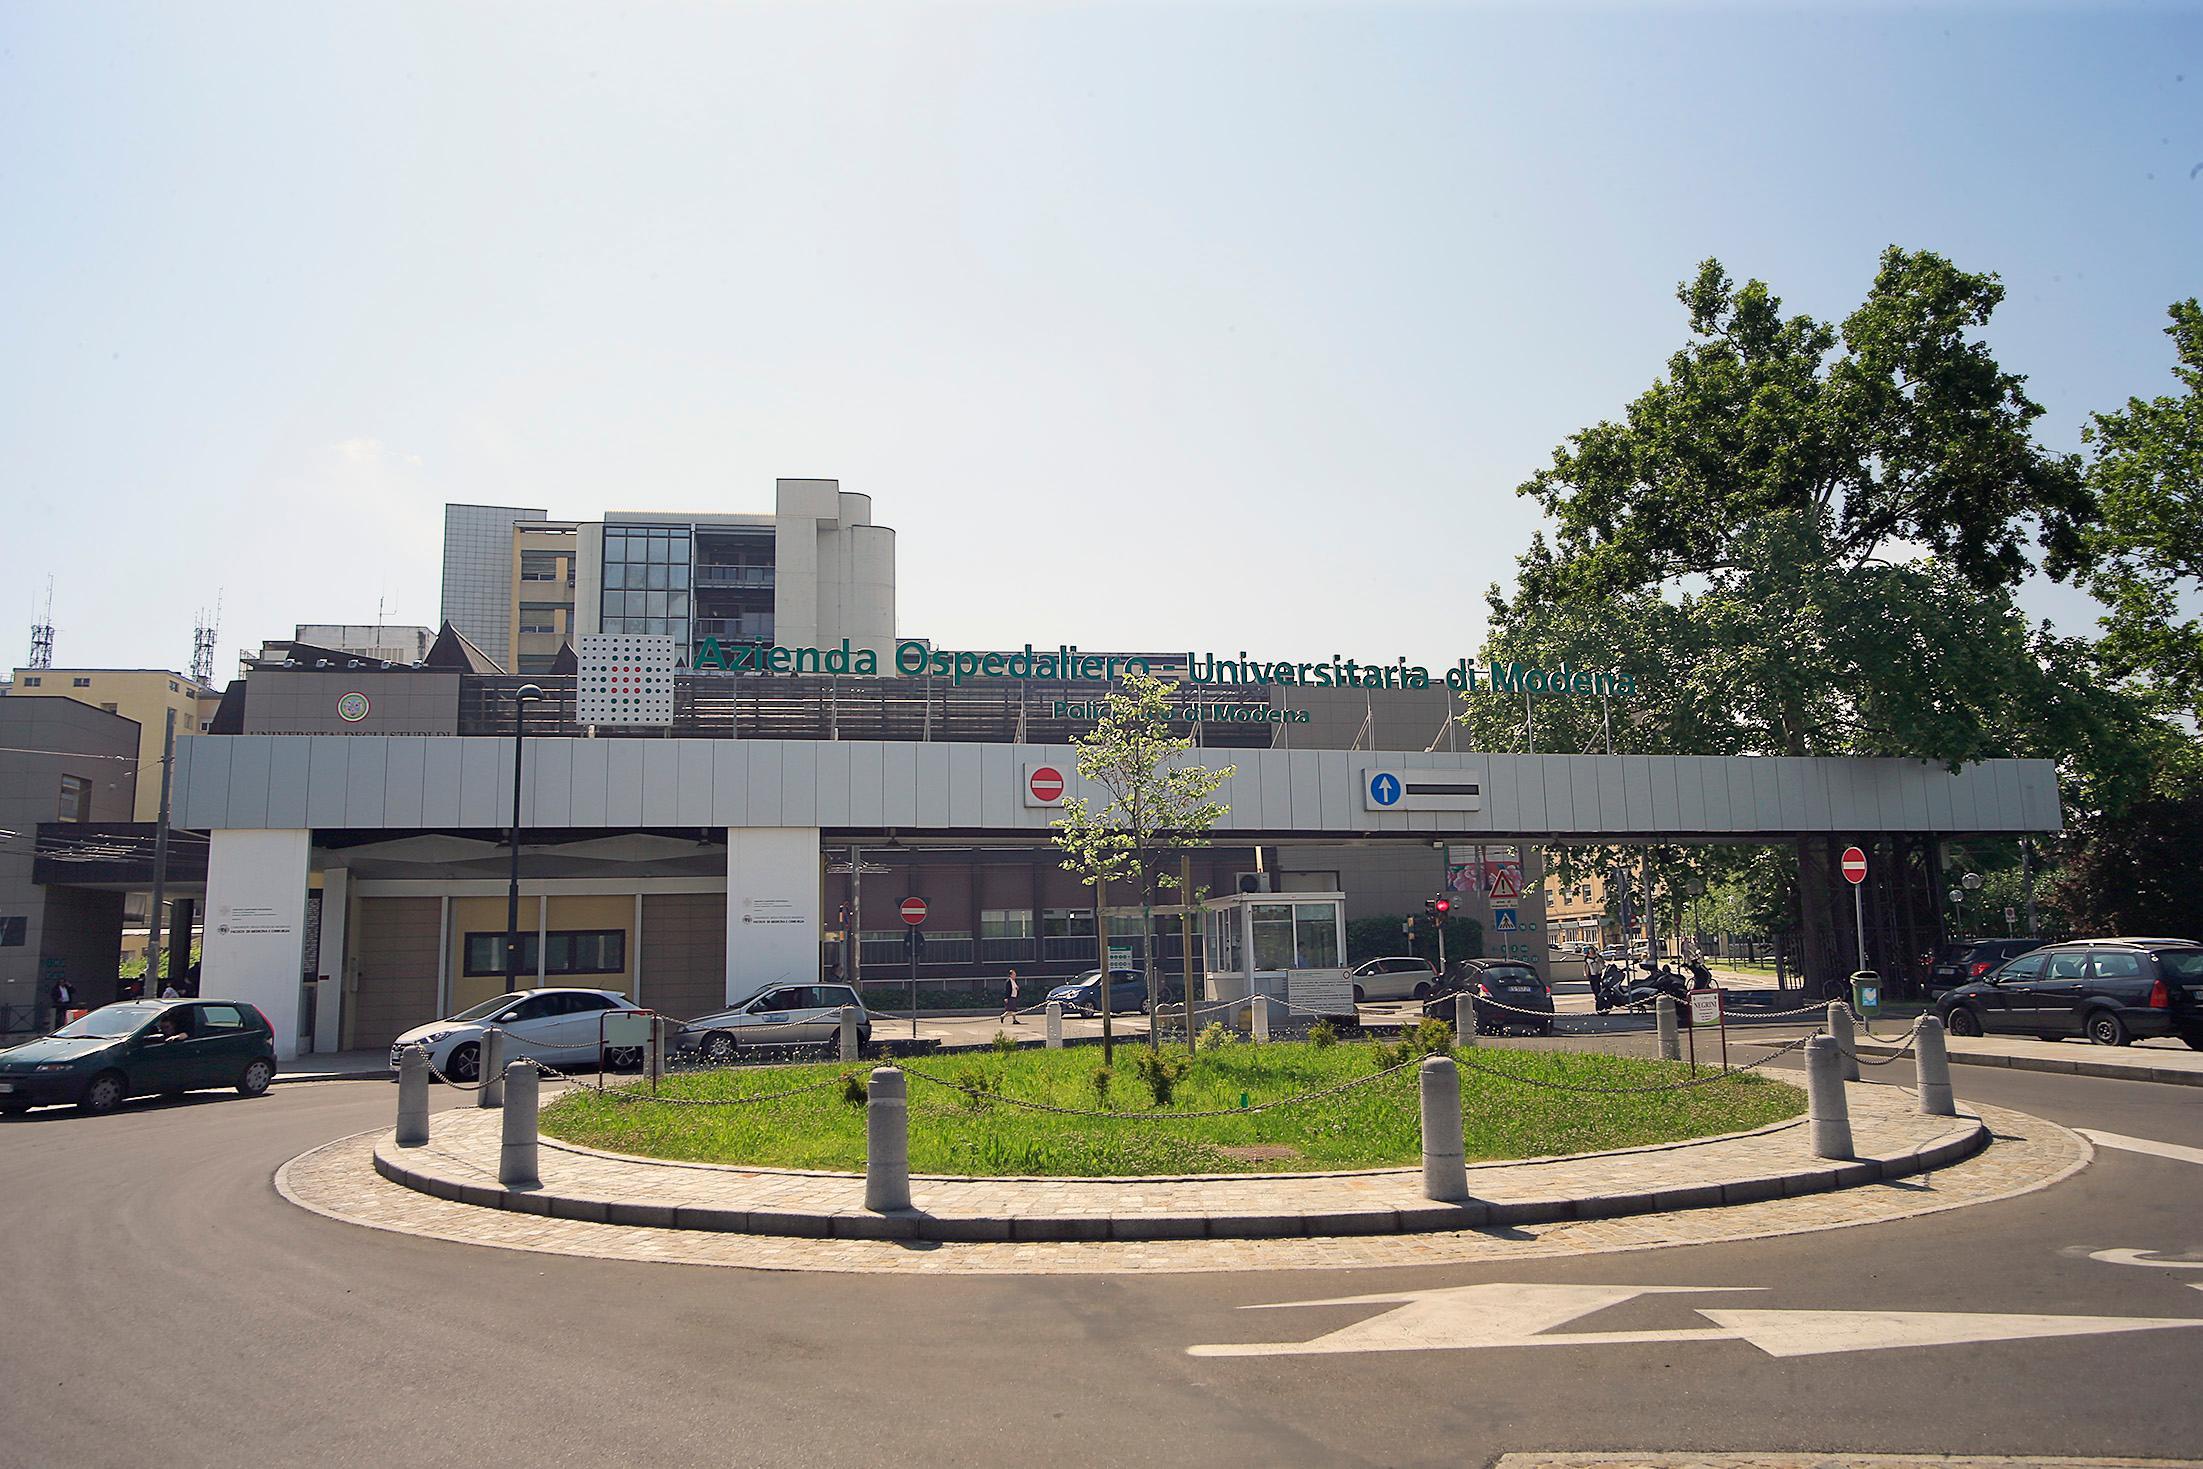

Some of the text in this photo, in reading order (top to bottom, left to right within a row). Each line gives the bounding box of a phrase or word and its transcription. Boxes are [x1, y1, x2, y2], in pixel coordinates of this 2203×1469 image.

[694, 635, 877, 675] Azienda
[895, 640, 1150, 687] Ospedaliero
[1188, 651, 1429, 689] Universitaria
[1444, 658, 1477, 692] di
[1488, 661, 1637, 696] Modena
[1182, 702, 1205, 722] di
[1211, 703, 1310, 724] Modena
